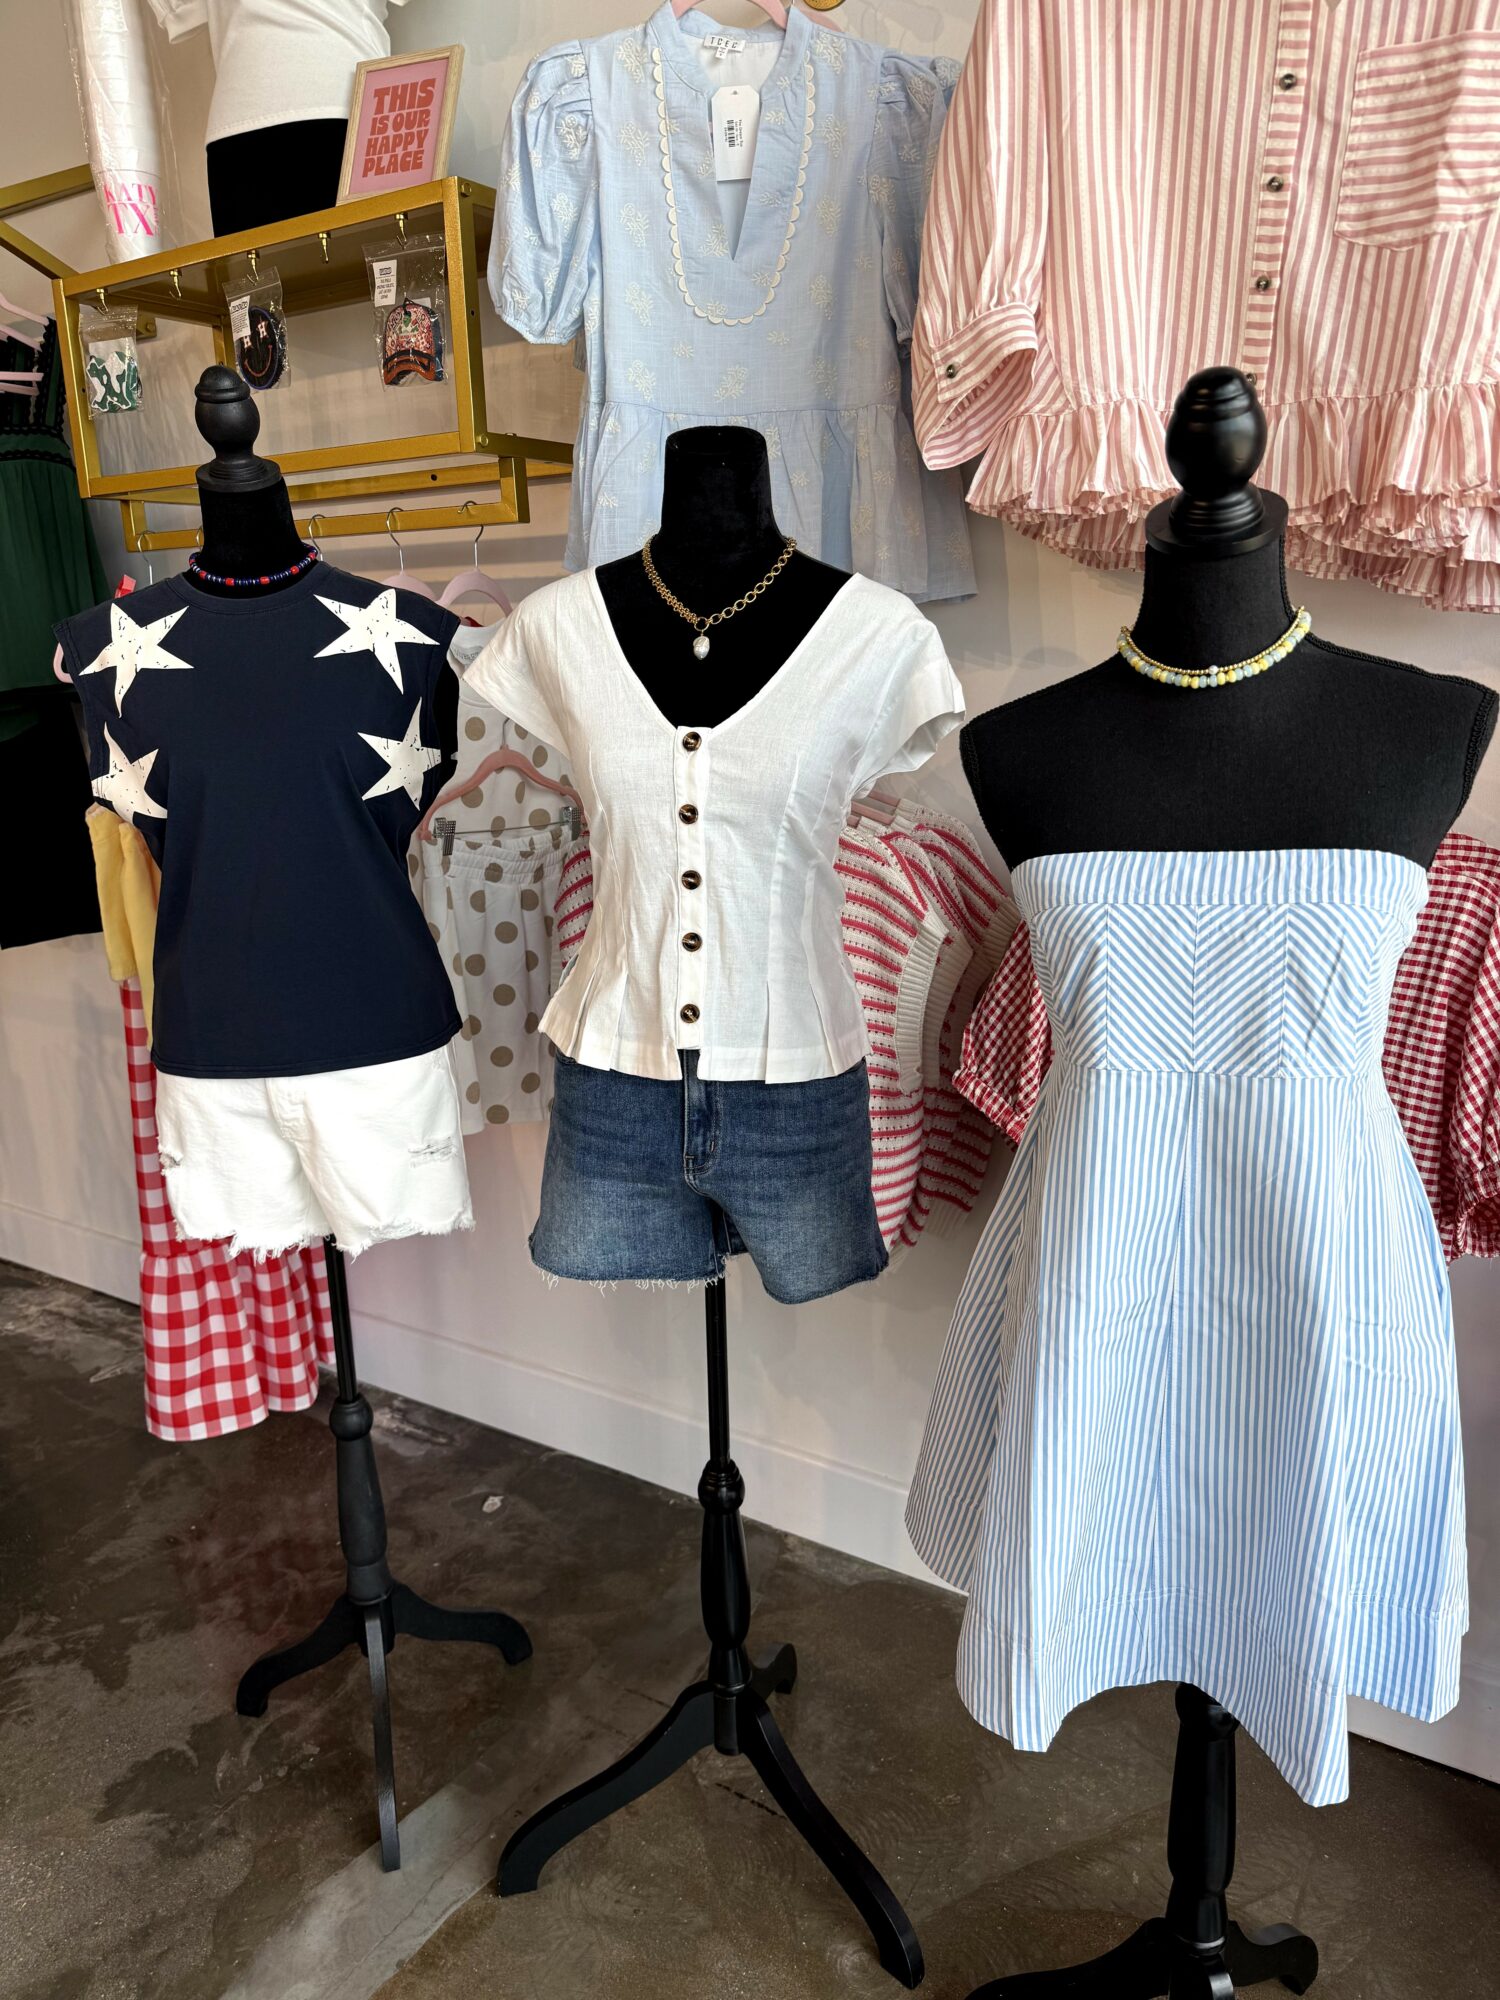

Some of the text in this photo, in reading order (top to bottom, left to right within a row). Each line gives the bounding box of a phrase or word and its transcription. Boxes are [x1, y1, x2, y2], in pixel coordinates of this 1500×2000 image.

[373, 78, 436, 115] THIS
[370, 109, 431, 136] IS OUR
[365, 129, 429, 157] HAPPY
[362, 150, 424, 178] PLACE
[103, 183, 156, 206] KATY
[107, 202, 153, 236] TX
